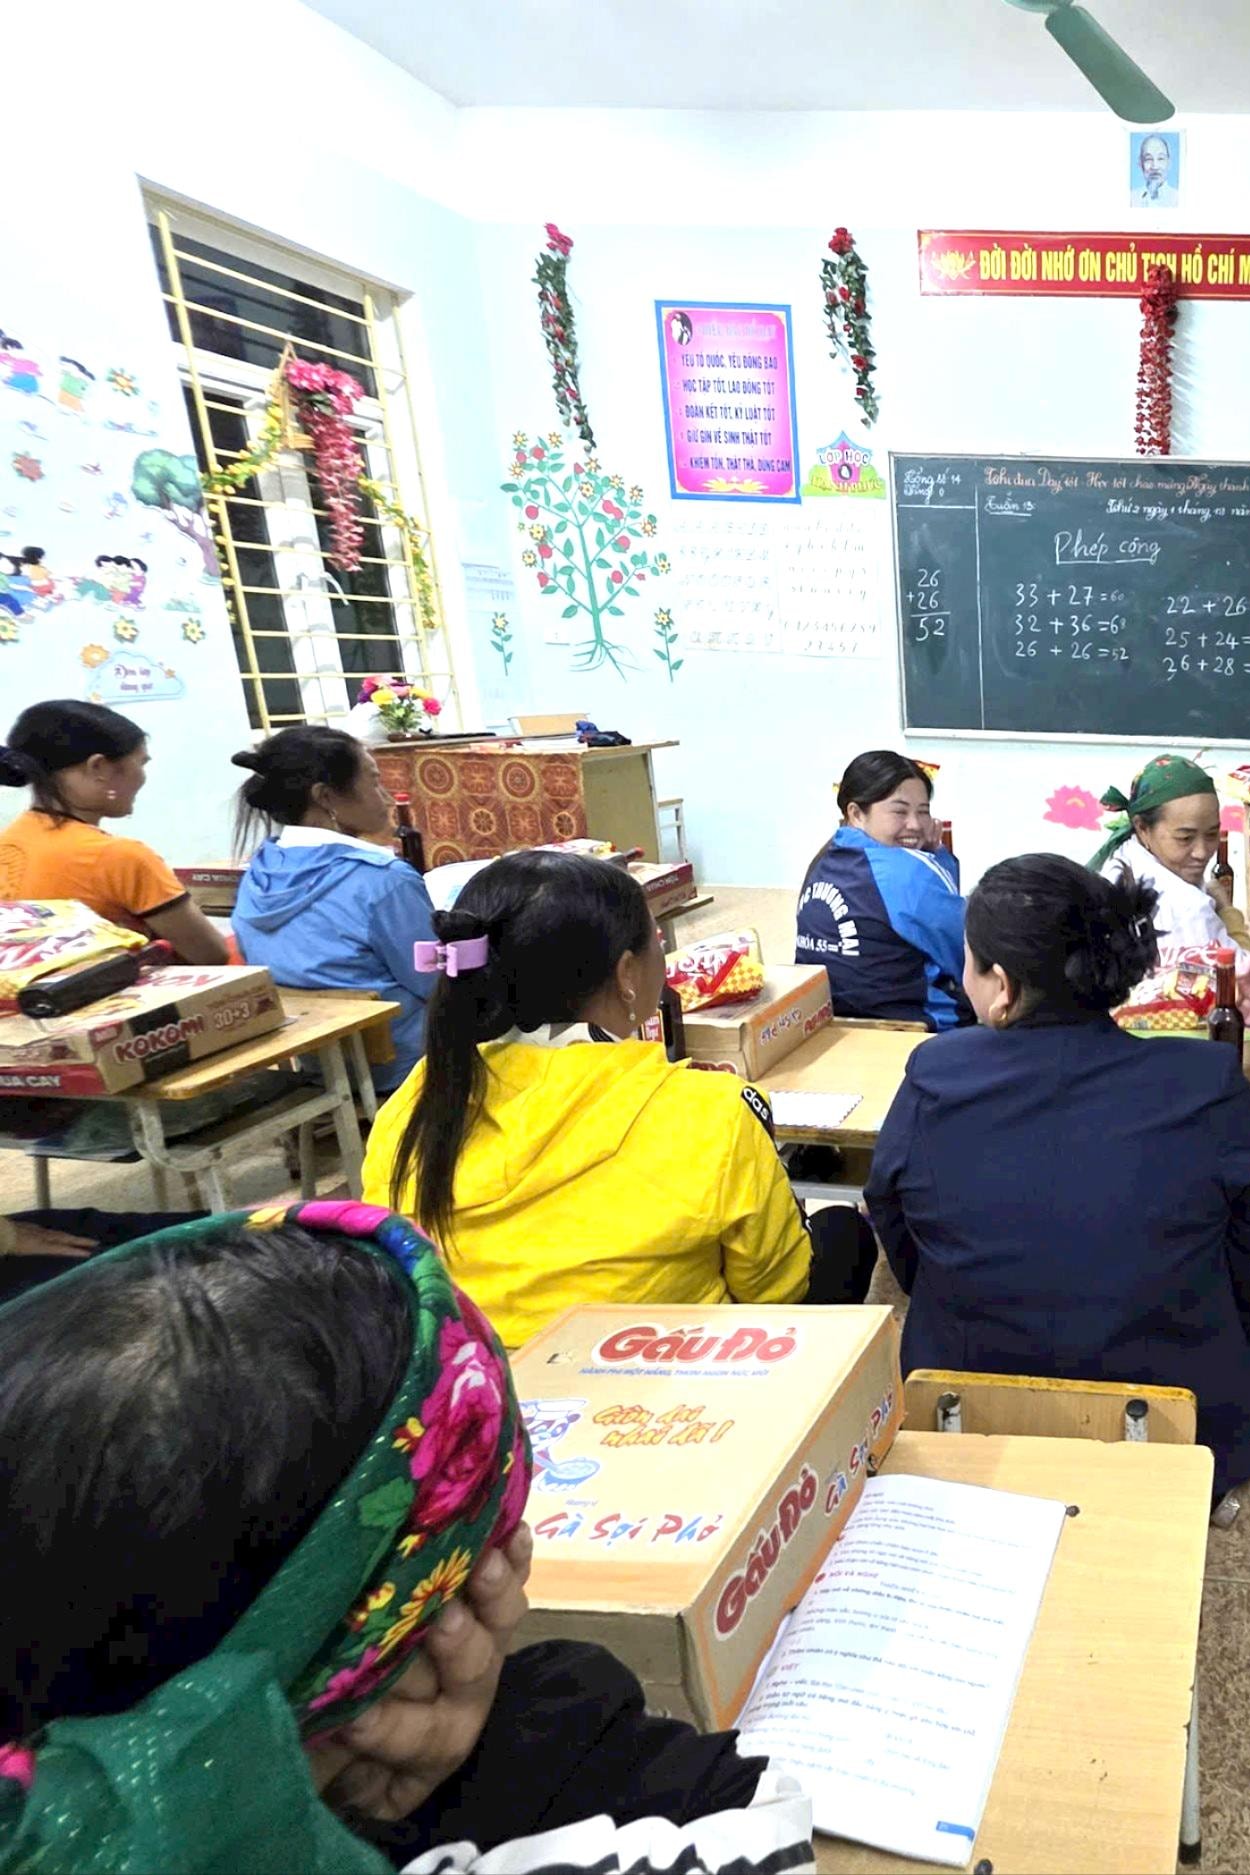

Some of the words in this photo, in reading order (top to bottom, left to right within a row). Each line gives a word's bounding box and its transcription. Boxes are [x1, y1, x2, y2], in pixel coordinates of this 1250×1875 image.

[979, 242, 1006, 281] ĐỜI
[1010, 243, 1037, 281] ĐỜI
[1041, 244, 1075, 281] NHỚ
[1078, 250, 1101, 282] ƠN
[1105, 242, 1137, 282] CHỦ
[1182, 244, 1202, 284] HỒ
[1207, 248, 1235, 284] CHÍ
[1055, 528, 1108, 563] Phép
[1119, 537, 1162, 564] cộng
[917, 569, 942, 588] 26
[917, 591, 940, 610] 26
[1015, 583, 1039, 608] 33
[1068, 585, 1094, 606] 27
[1166, 596, 1196, 614] 22
[1224, 596, 1247, 616] 26
[916, 616, 945, 641] 52
[1015, 615, 1042, 636] 32
[1070, 615, 1094, 636] 36
[1165, 627, 1190, 648] 25
[1215, 630, 1240, 650] 24
[1015, 640, 1038, 657] 26
[1070, 642, 1094, 660] 26
[1213, 656, 1235, 676] 28
[113, 1015, 205, 1063] KOKOMI
[26, 1075, 62, 1088] CAY
[534, 1512, 584, 1540] Gà
[588, 1512, 649, 1546] Sợi
[651, 1514, 724, 1543] Phở
